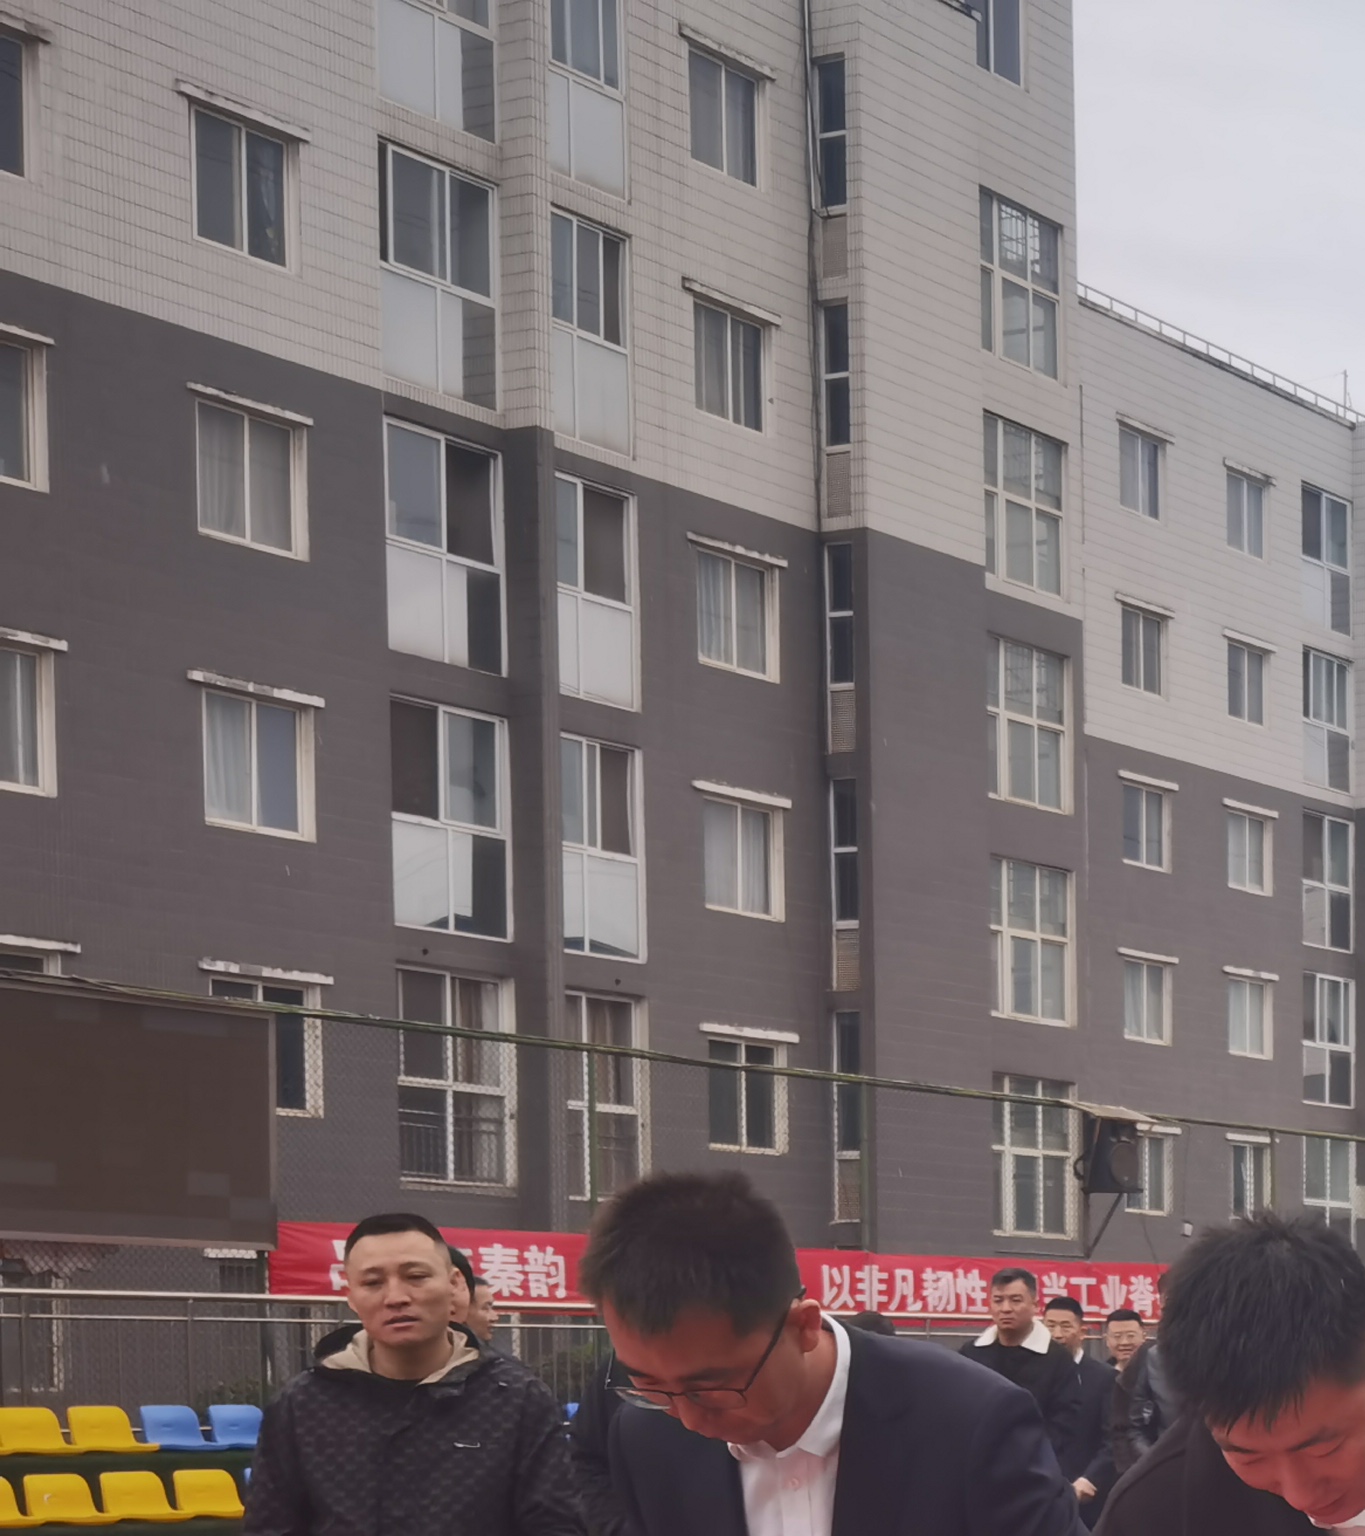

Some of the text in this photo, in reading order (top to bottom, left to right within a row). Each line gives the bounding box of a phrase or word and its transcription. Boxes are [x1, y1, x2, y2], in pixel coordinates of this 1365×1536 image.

[821, 1264, 989, 1313] 以非凡韧性
[1034, 1271, 1162, 1317] 当工业脊
